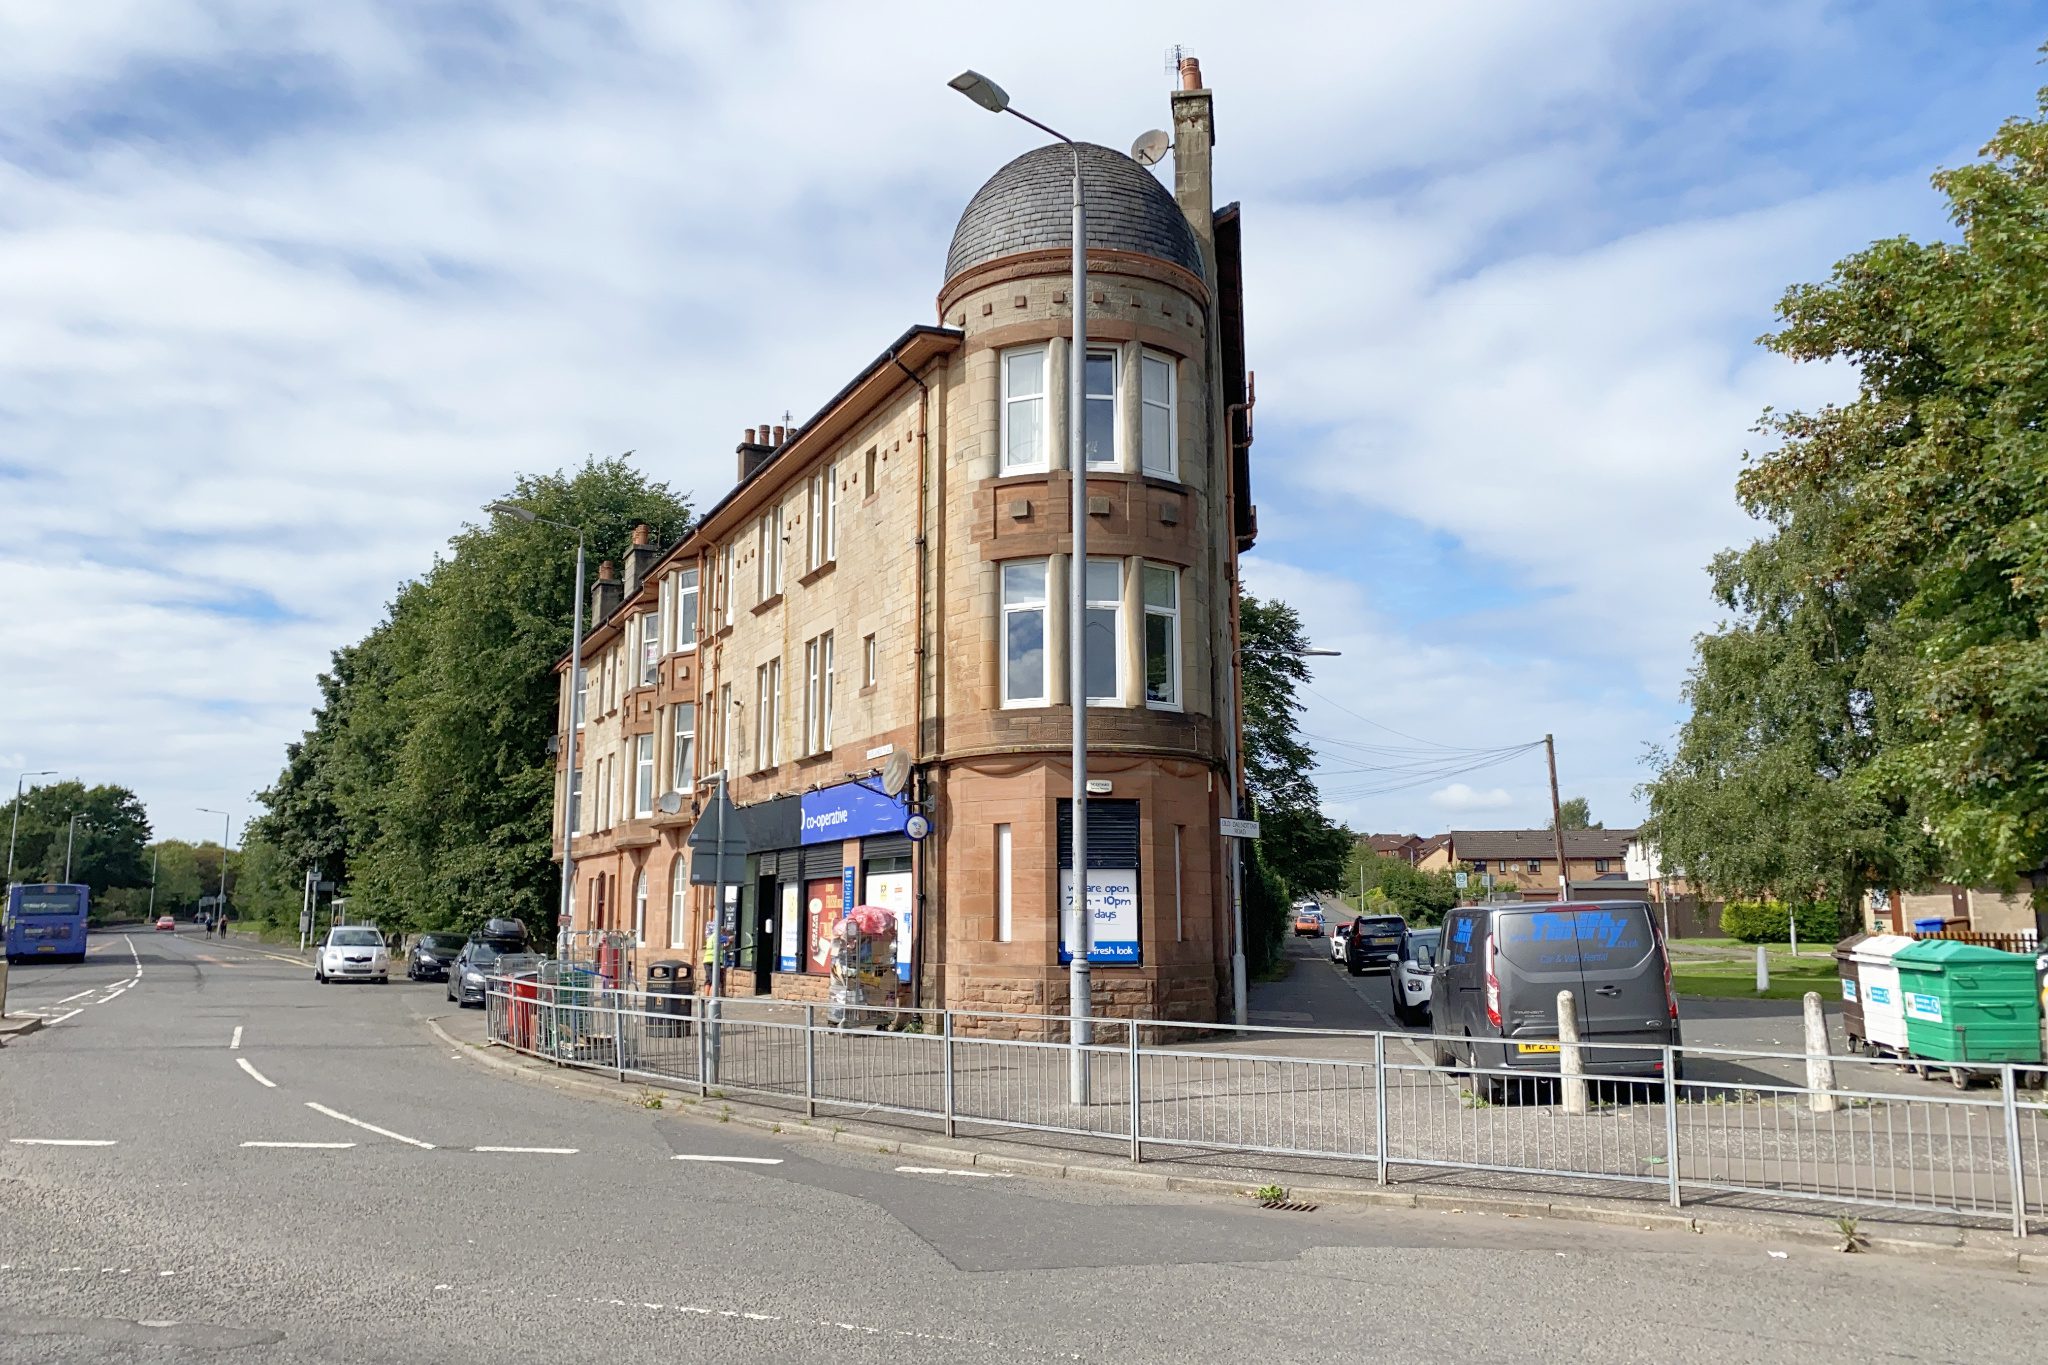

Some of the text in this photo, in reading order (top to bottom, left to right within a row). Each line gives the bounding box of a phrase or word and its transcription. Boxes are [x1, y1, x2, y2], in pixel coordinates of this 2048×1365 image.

[806, 807, 848, 832] co-operative
[1105, 885, 1129, 895] open
[1104, 895, 1132, 909] 10pm
[1094, 908, 1117, 922] days
[1094, 945, 1134, 955] fresh look
